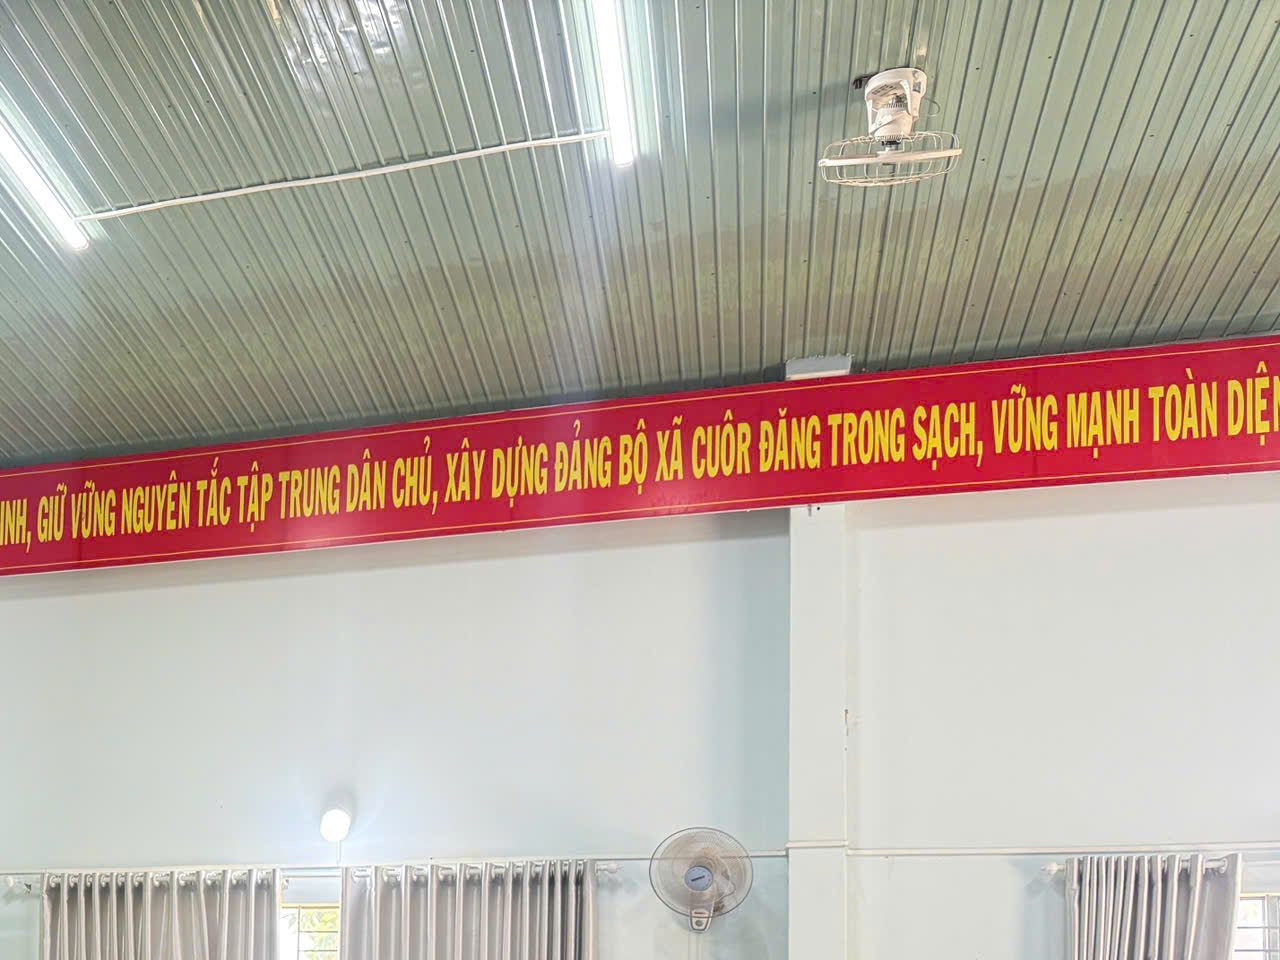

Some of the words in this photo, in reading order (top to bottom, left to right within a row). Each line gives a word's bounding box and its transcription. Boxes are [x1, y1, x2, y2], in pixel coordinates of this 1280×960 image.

[37, 482, 67, 543] GIỮ
[71, 480, 116, 539] VỮNG
[121, 470, 191, 534] NGUYÊN
[197, 457, 231, 527] TẮC
[237, 461, 273, 532] TẬP
[278, 465, 340, 519] TRUNG
[345, 449, 387, 513] DÂN
[392, 435, 438, 515] CHỦ,
[444, 438, 486, 503] XÂY
[492, 436, 549, 508] DỰNG
[554, 419, 612, 492] ĐẢNG
[618, 418, 648, 495] BỘ
[655, 415, 683, 482] XÃ
[691, 409, 751, 479] CUÔR
[759, 407, 820, 473] ĐĂNG
[828, 408, 905, 467] TRONG
[912, 401, 983, 470] SẠCH,
[991, 384, 1058, 454] VỮNG
[1066, 388, 1140, 459] MẠNH
[1148, 367, 1218, 442] TOÀN
